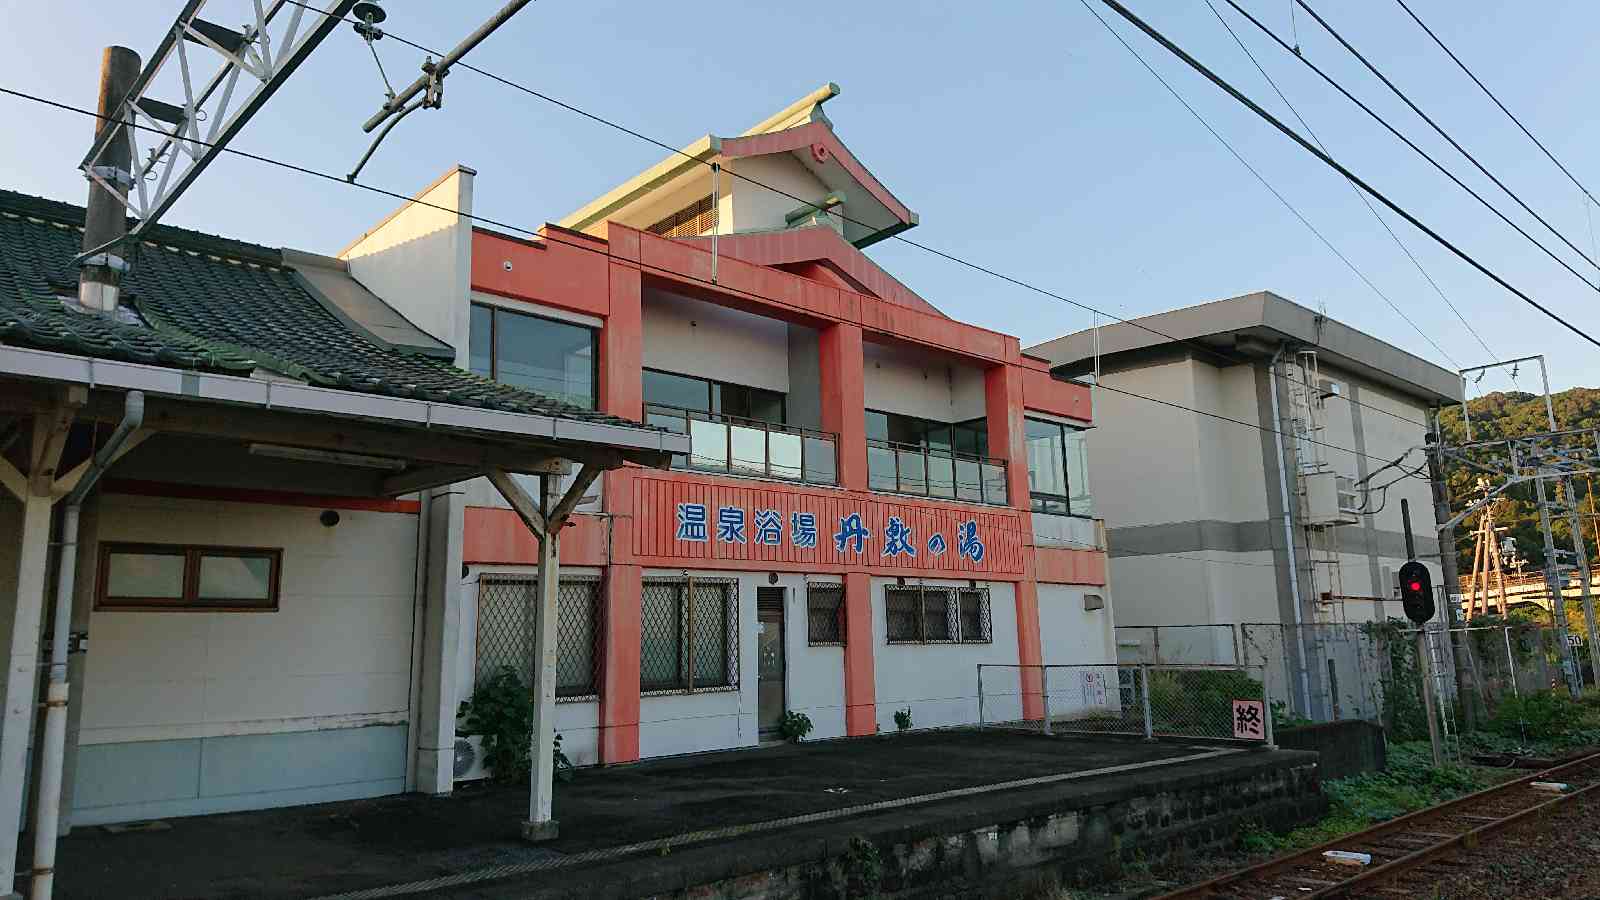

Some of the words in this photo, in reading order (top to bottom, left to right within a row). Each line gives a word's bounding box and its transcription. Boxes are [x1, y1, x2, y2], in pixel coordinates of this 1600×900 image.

[676, 503, 817, 548] 温泉浴場
[834, 514, 984, 562] 丹敷の湯
[1567, 635, 1582, 645] 50
[1236, 705, 1261, 734] 終
